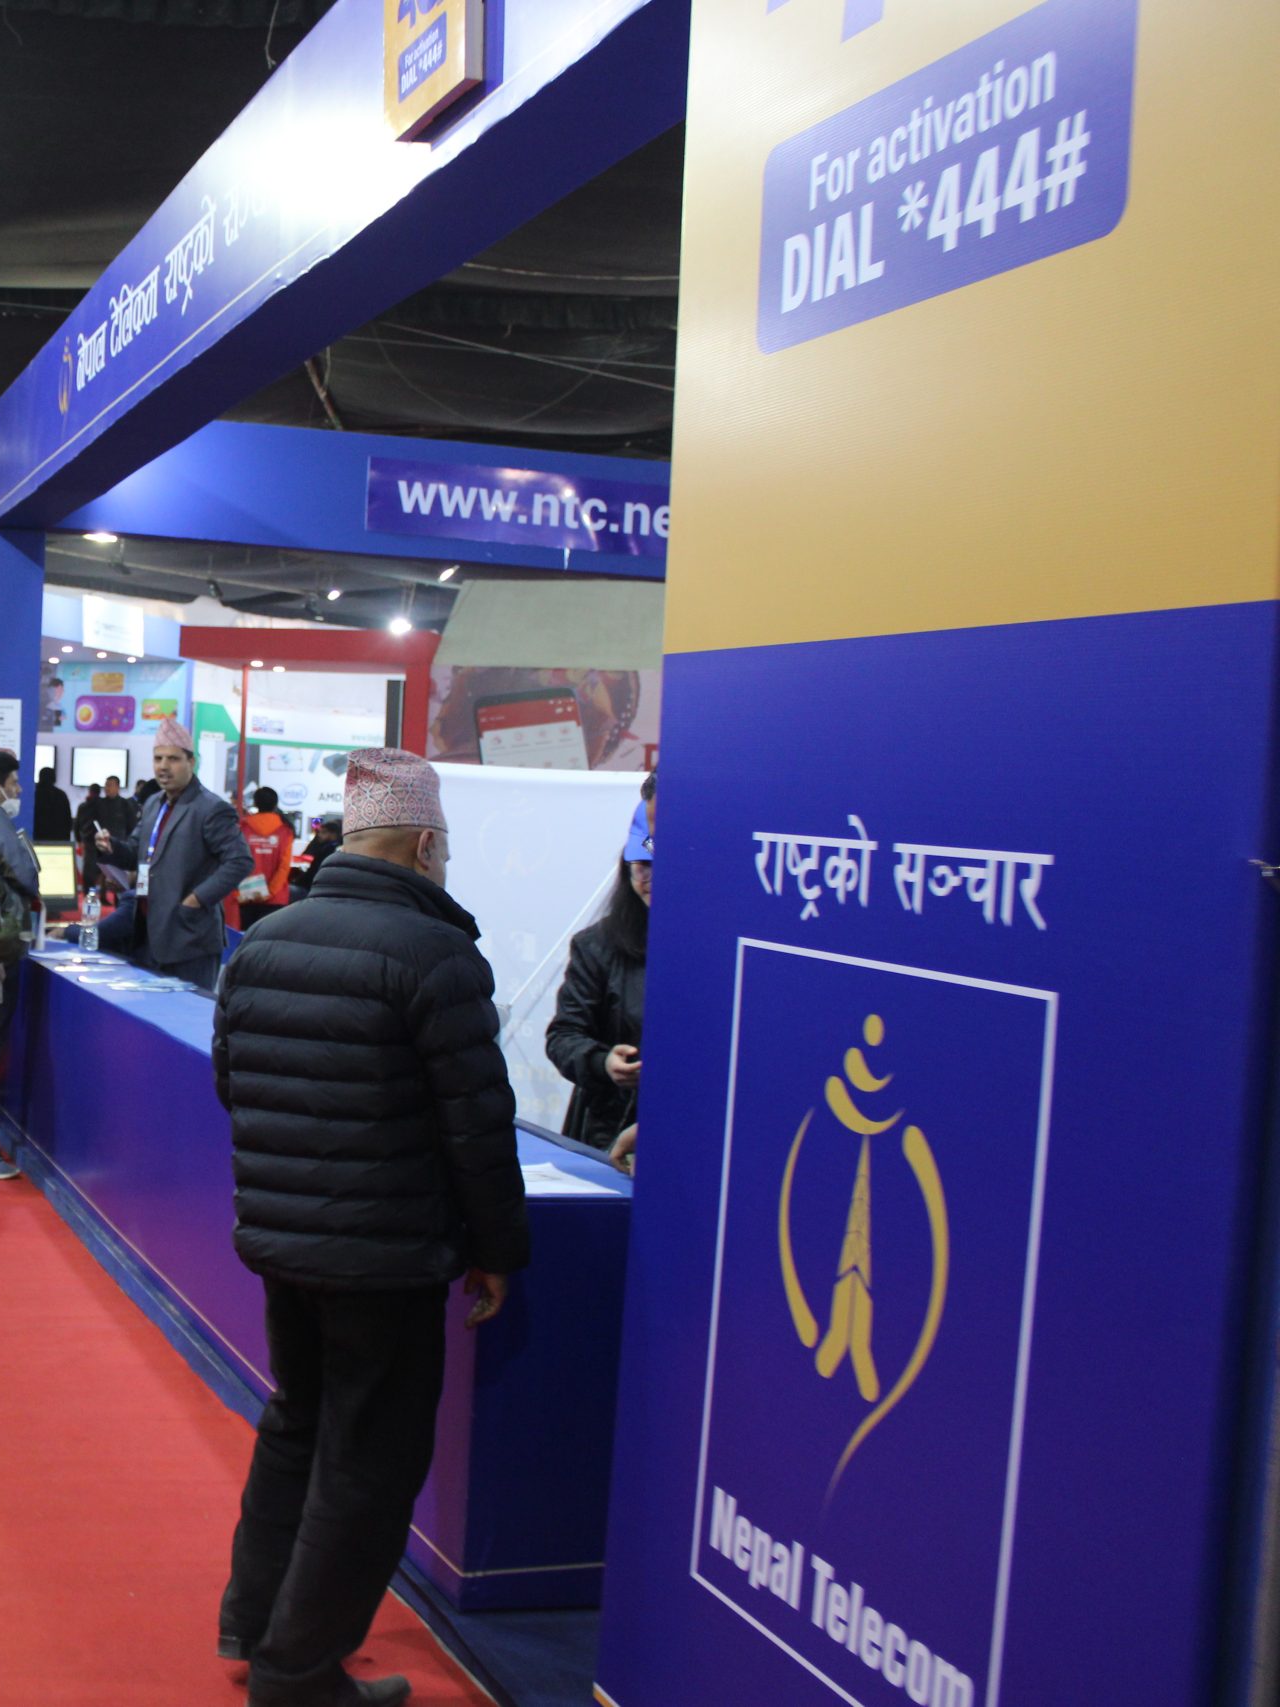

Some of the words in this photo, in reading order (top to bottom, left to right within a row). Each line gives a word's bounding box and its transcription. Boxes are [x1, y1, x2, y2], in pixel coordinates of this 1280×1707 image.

[400, 63, 418, 94] DIAL
[808, 149, 862, 212] For
[866, 50, 1058, 186] activation
[780, 200, 886, 315] DIAL
[76, 320, 108, 391] नेपाल
[397, 480, 670, 538] www.ntc.ne
[318, 791, 344, 802] AMD
[752, 814, 878, 921] राष्ट्रको
[892, 842, 1055, 931] सञ्चार
[709, 1485, 805, 1612] Nepal
[811, 1553, 975, 1707] Telecom
